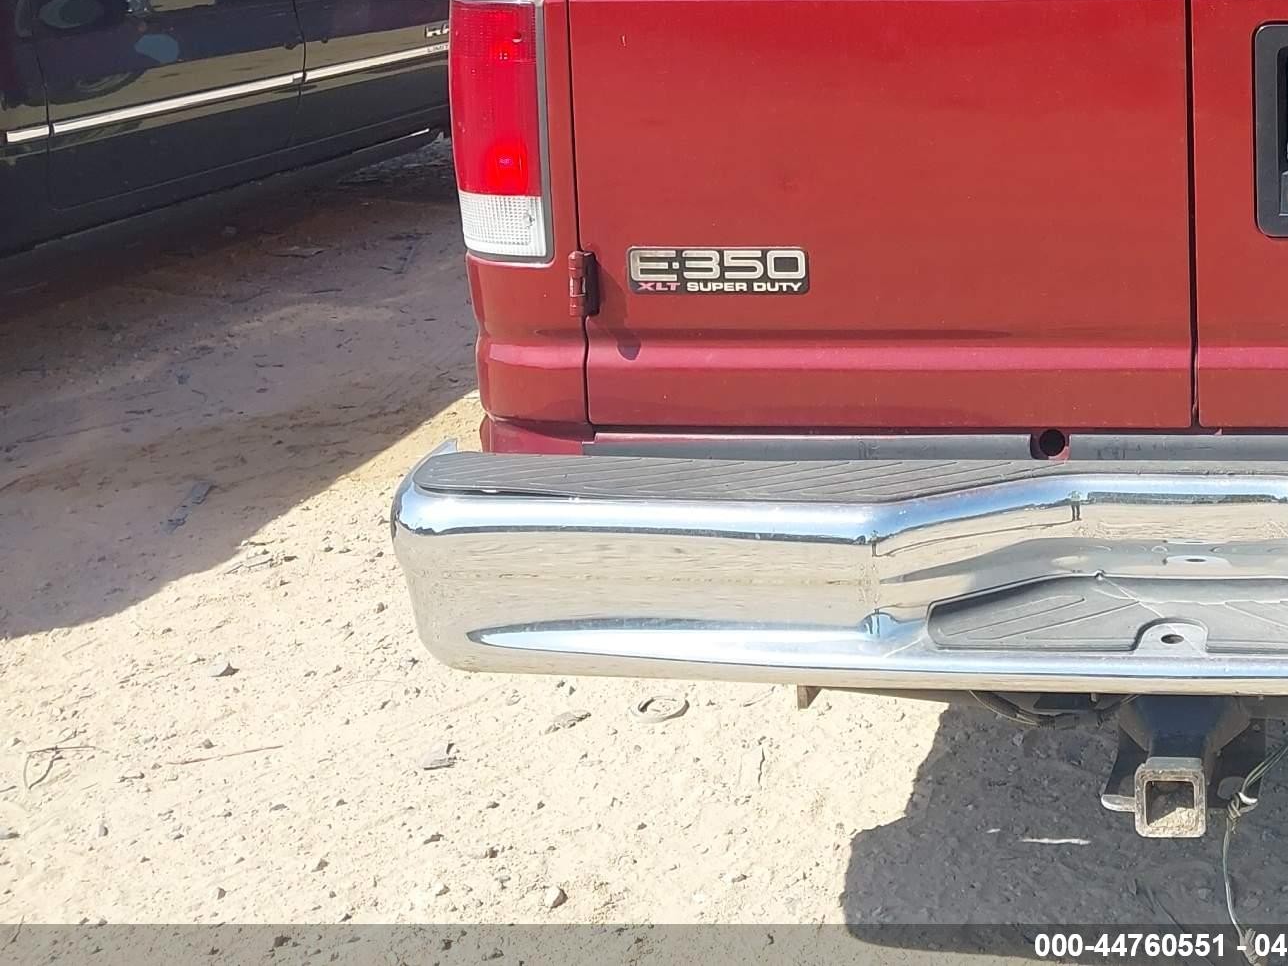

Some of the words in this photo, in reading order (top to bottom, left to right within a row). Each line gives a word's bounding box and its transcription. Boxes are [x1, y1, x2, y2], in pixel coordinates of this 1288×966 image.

[637, 282, 681, 291] XLT
[686, 282, 748, 292] SUPER
[753, 282, 802, 292] DUTY
